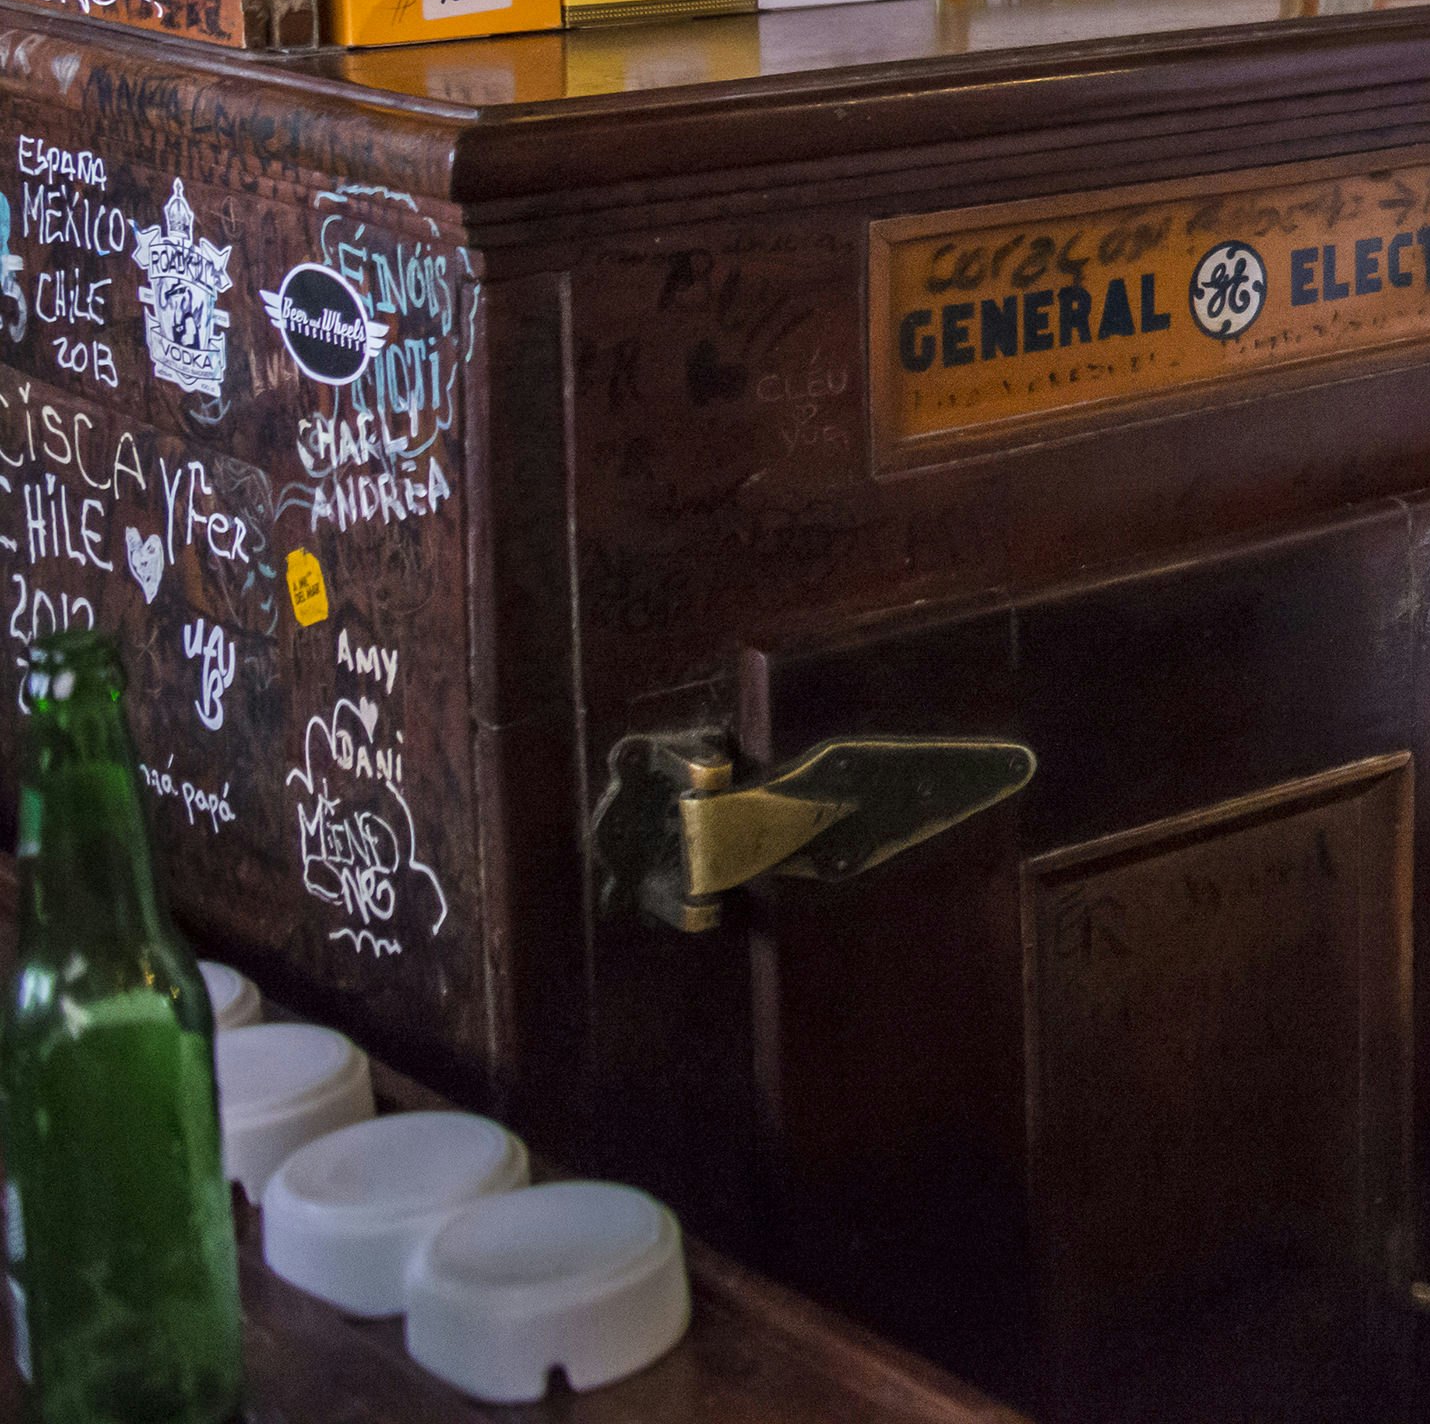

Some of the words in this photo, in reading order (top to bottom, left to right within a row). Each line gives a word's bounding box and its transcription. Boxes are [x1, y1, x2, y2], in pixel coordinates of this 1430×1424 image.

[282, 296, 309, 325] Beer
[322, 307, 367, 342] Wheels
[900, 273, 1171, 372] GENERAL
[161, 338, 213, 371] VODKA
